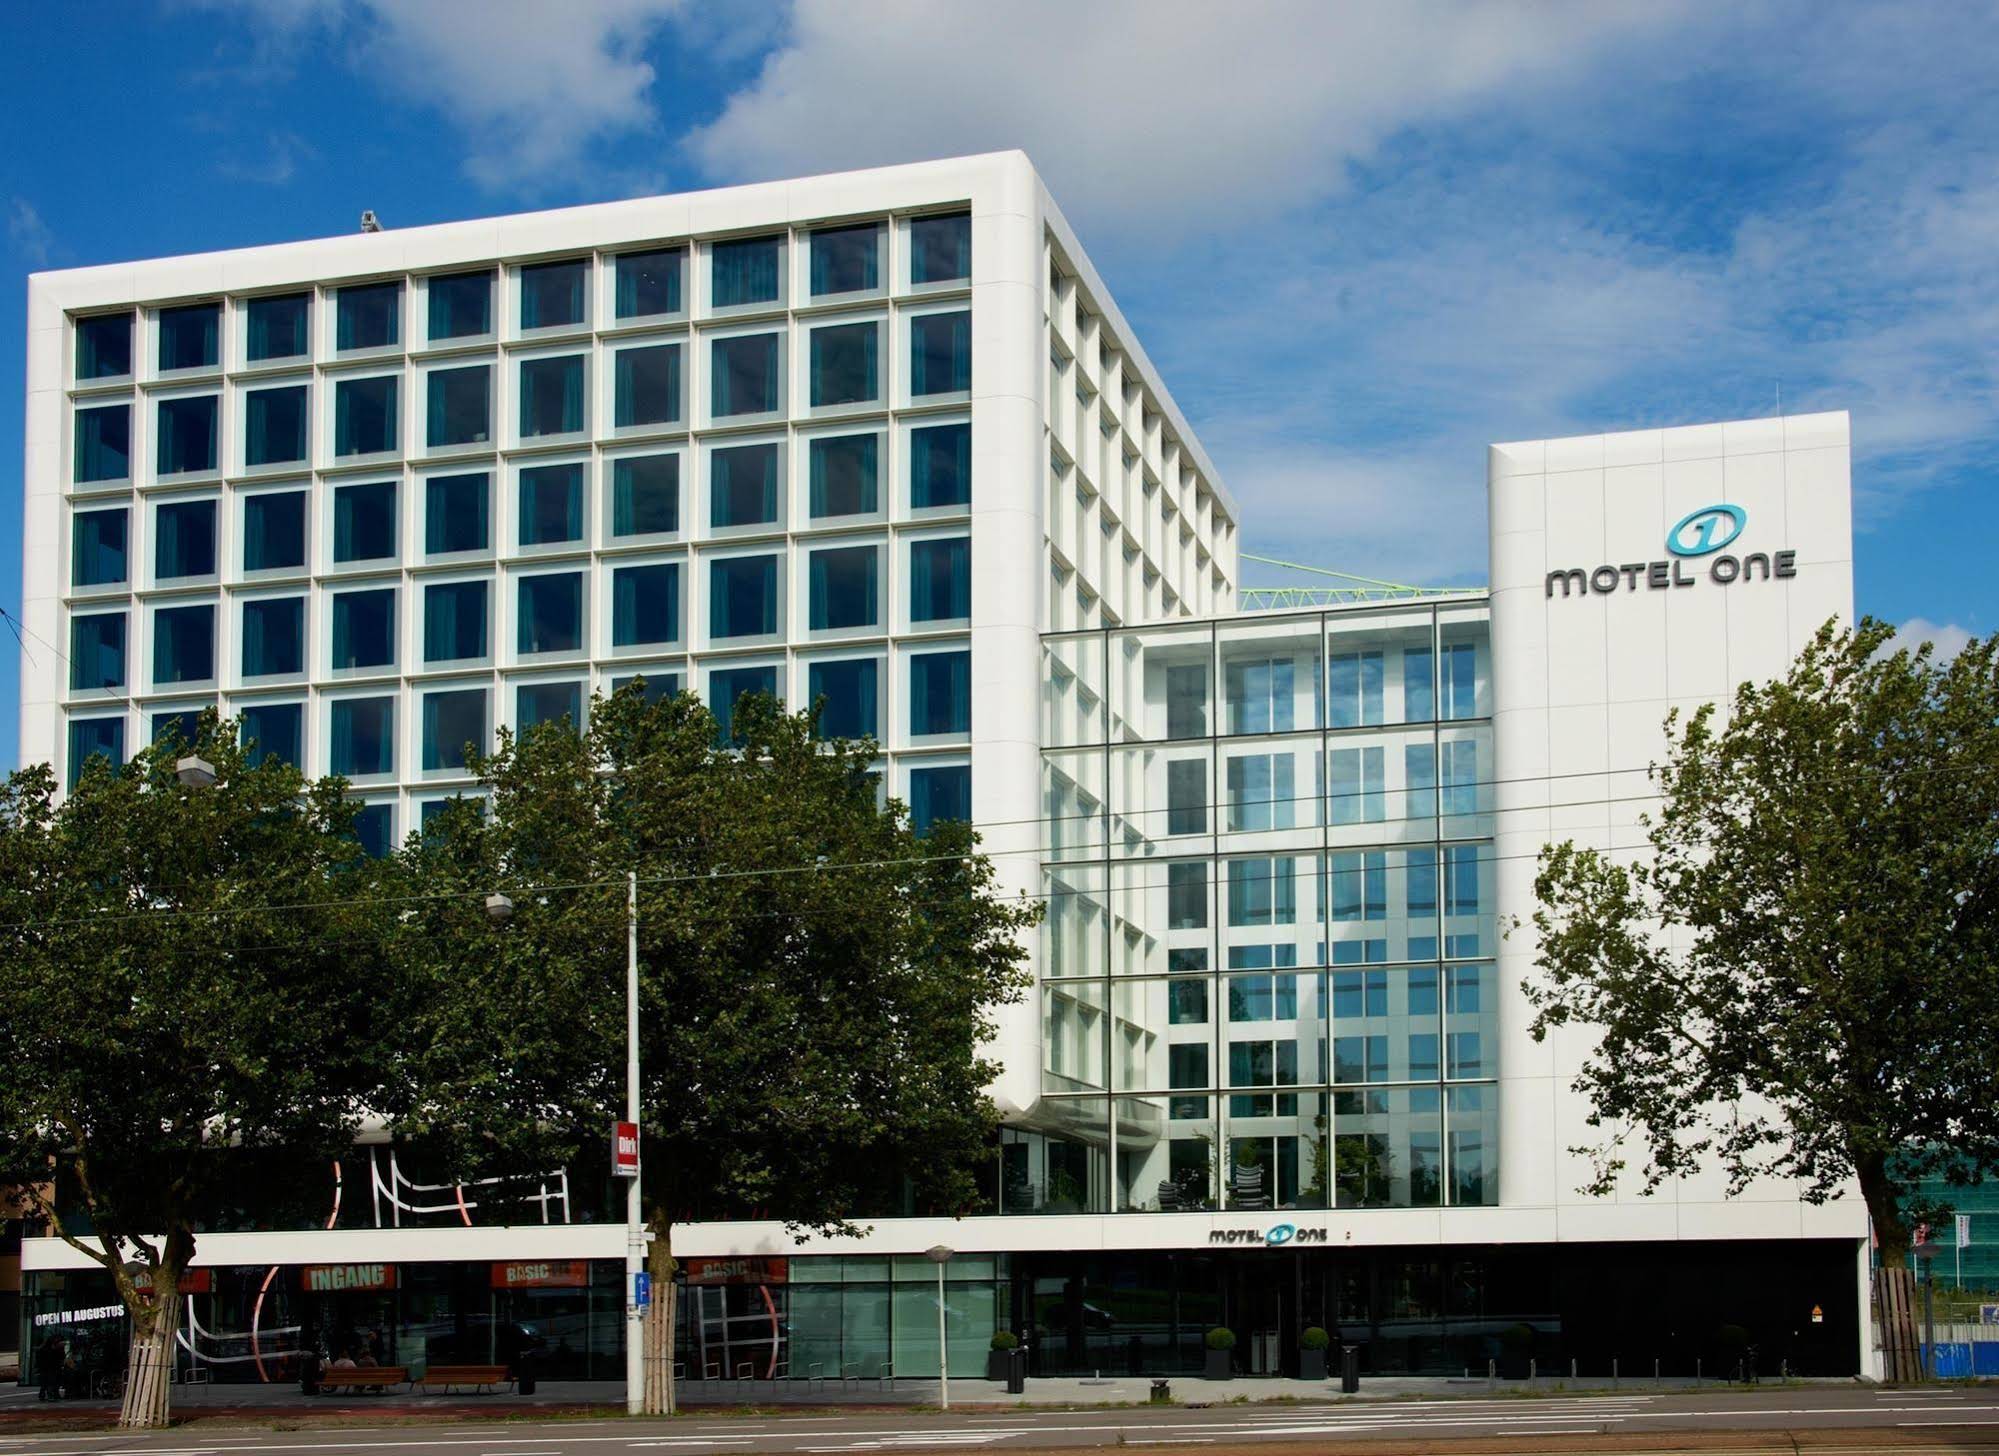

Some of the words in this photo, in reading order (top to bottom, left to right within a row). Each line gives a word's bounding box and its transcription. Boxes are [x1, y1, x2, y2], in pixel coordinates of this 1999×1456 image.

[619, 1136, 637, 1154] Dirk
[311, 1264, 384, 1290] INGANG
[507, 1264, 549, 1282] BASIC
[703, 1260, 747, 1279] BASIC
[35, 1313, 60, 1326] OPEN
[61, 1310, 72, 1323] IN
[74, 1305, 124, 1322] AUGUSTUS
